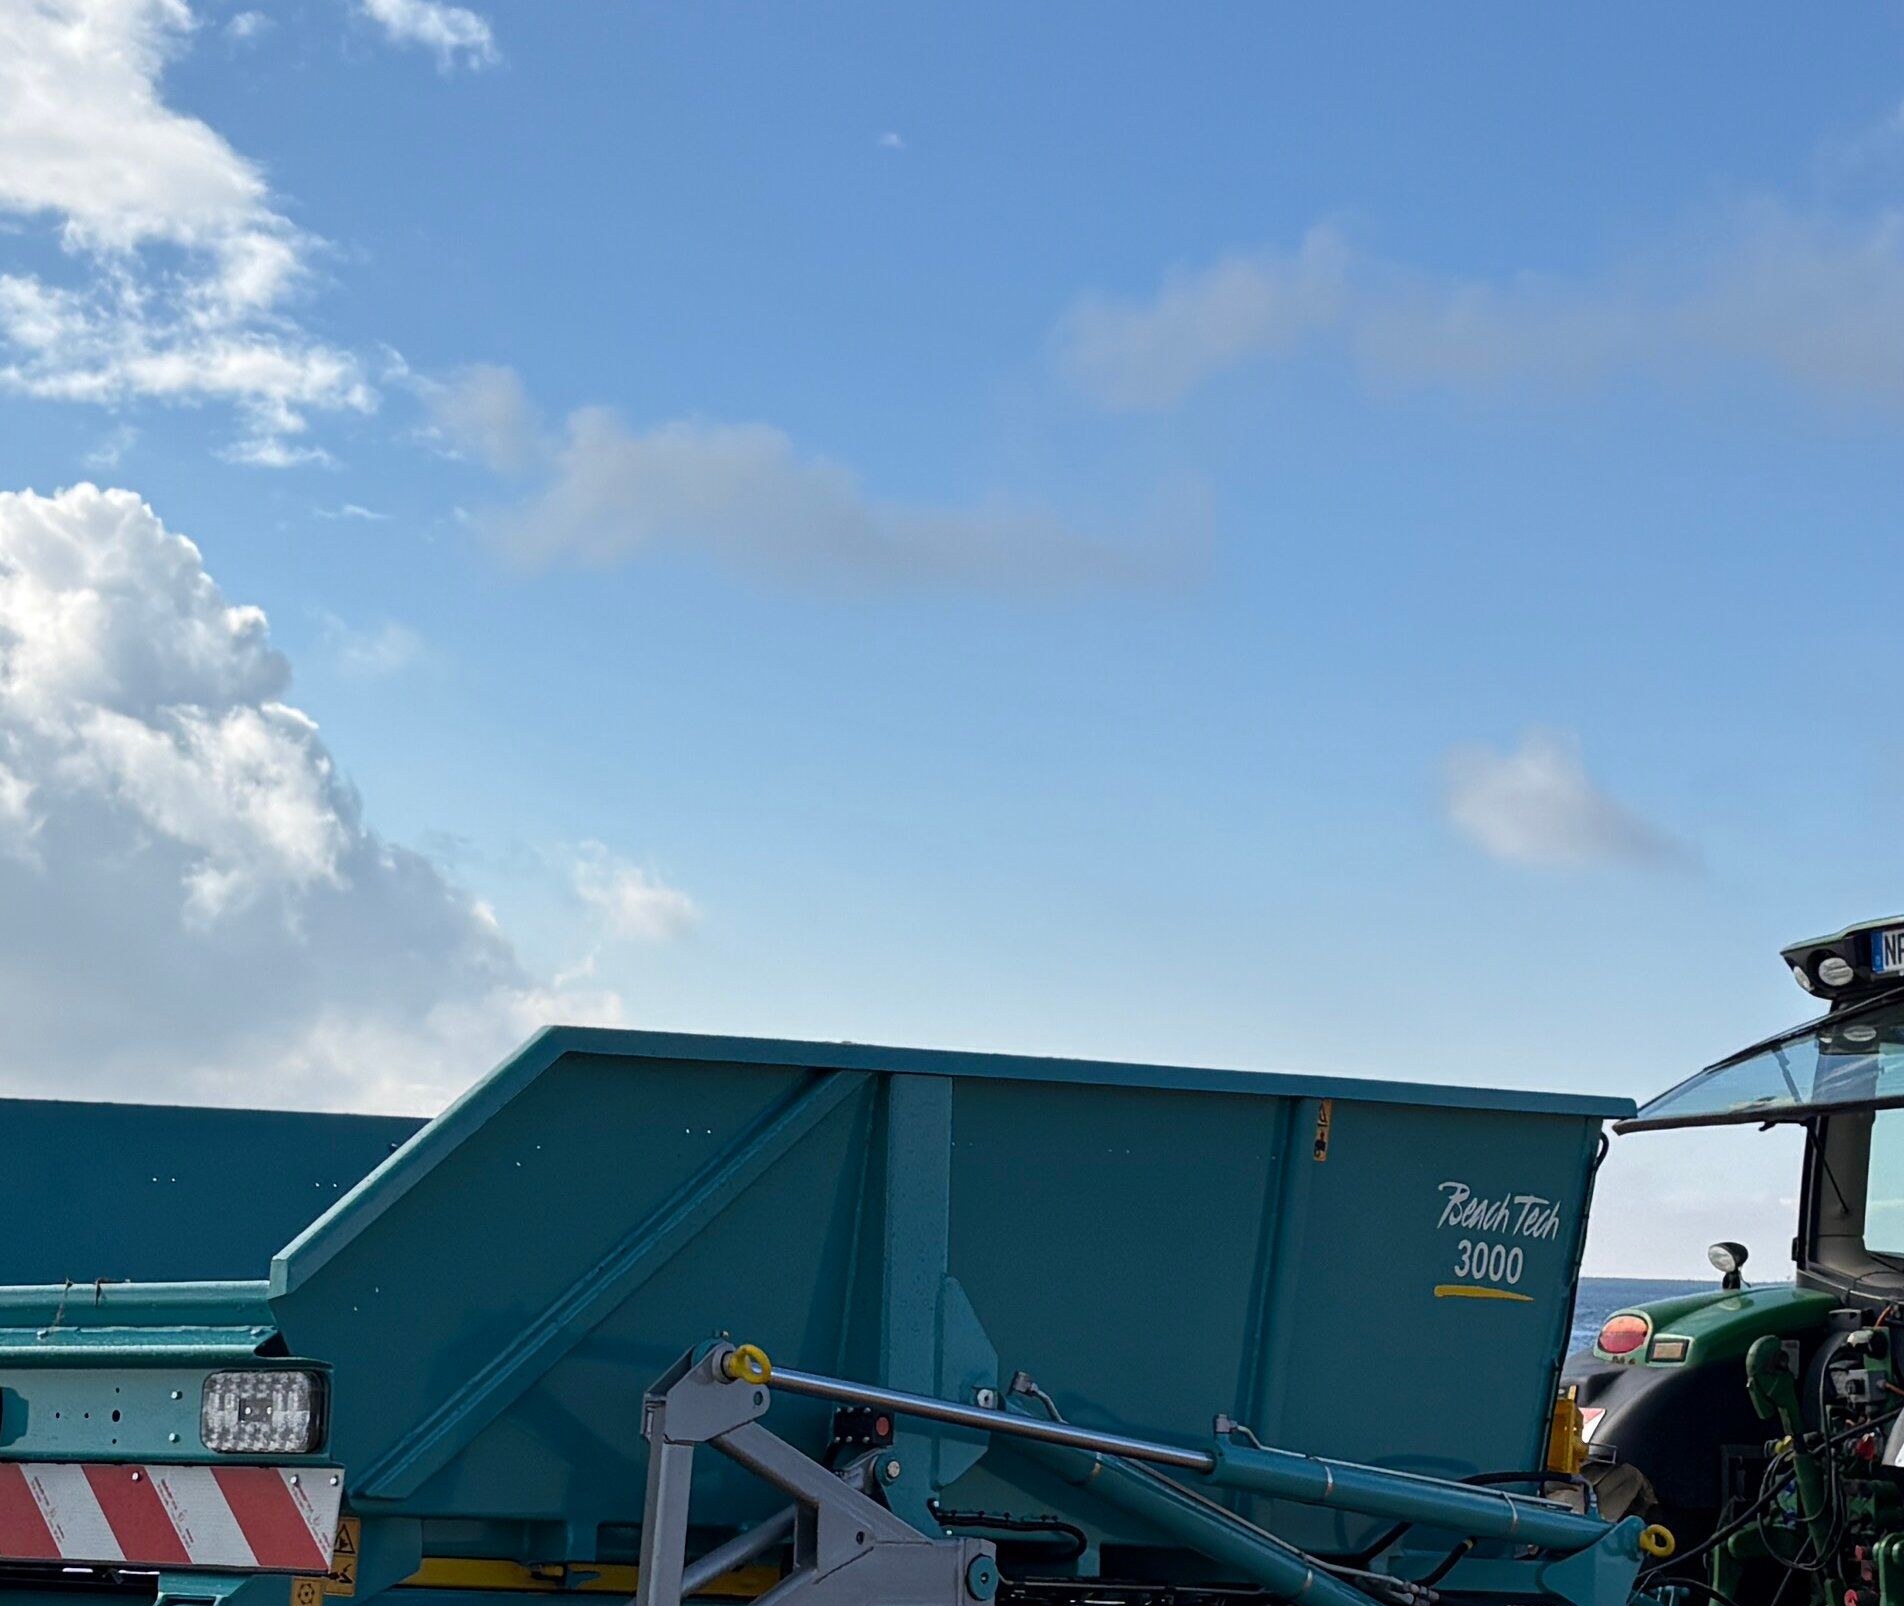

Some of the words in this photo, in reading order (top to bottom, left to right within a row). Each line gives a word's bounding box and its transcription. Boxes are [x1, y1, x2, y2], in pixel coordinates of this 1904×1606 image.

[1437, 1181, 1510, 1233] Beach
[1513, 1195, 1561, 1240] Tech
[1454, 1239, 1523, 1284] 3000
